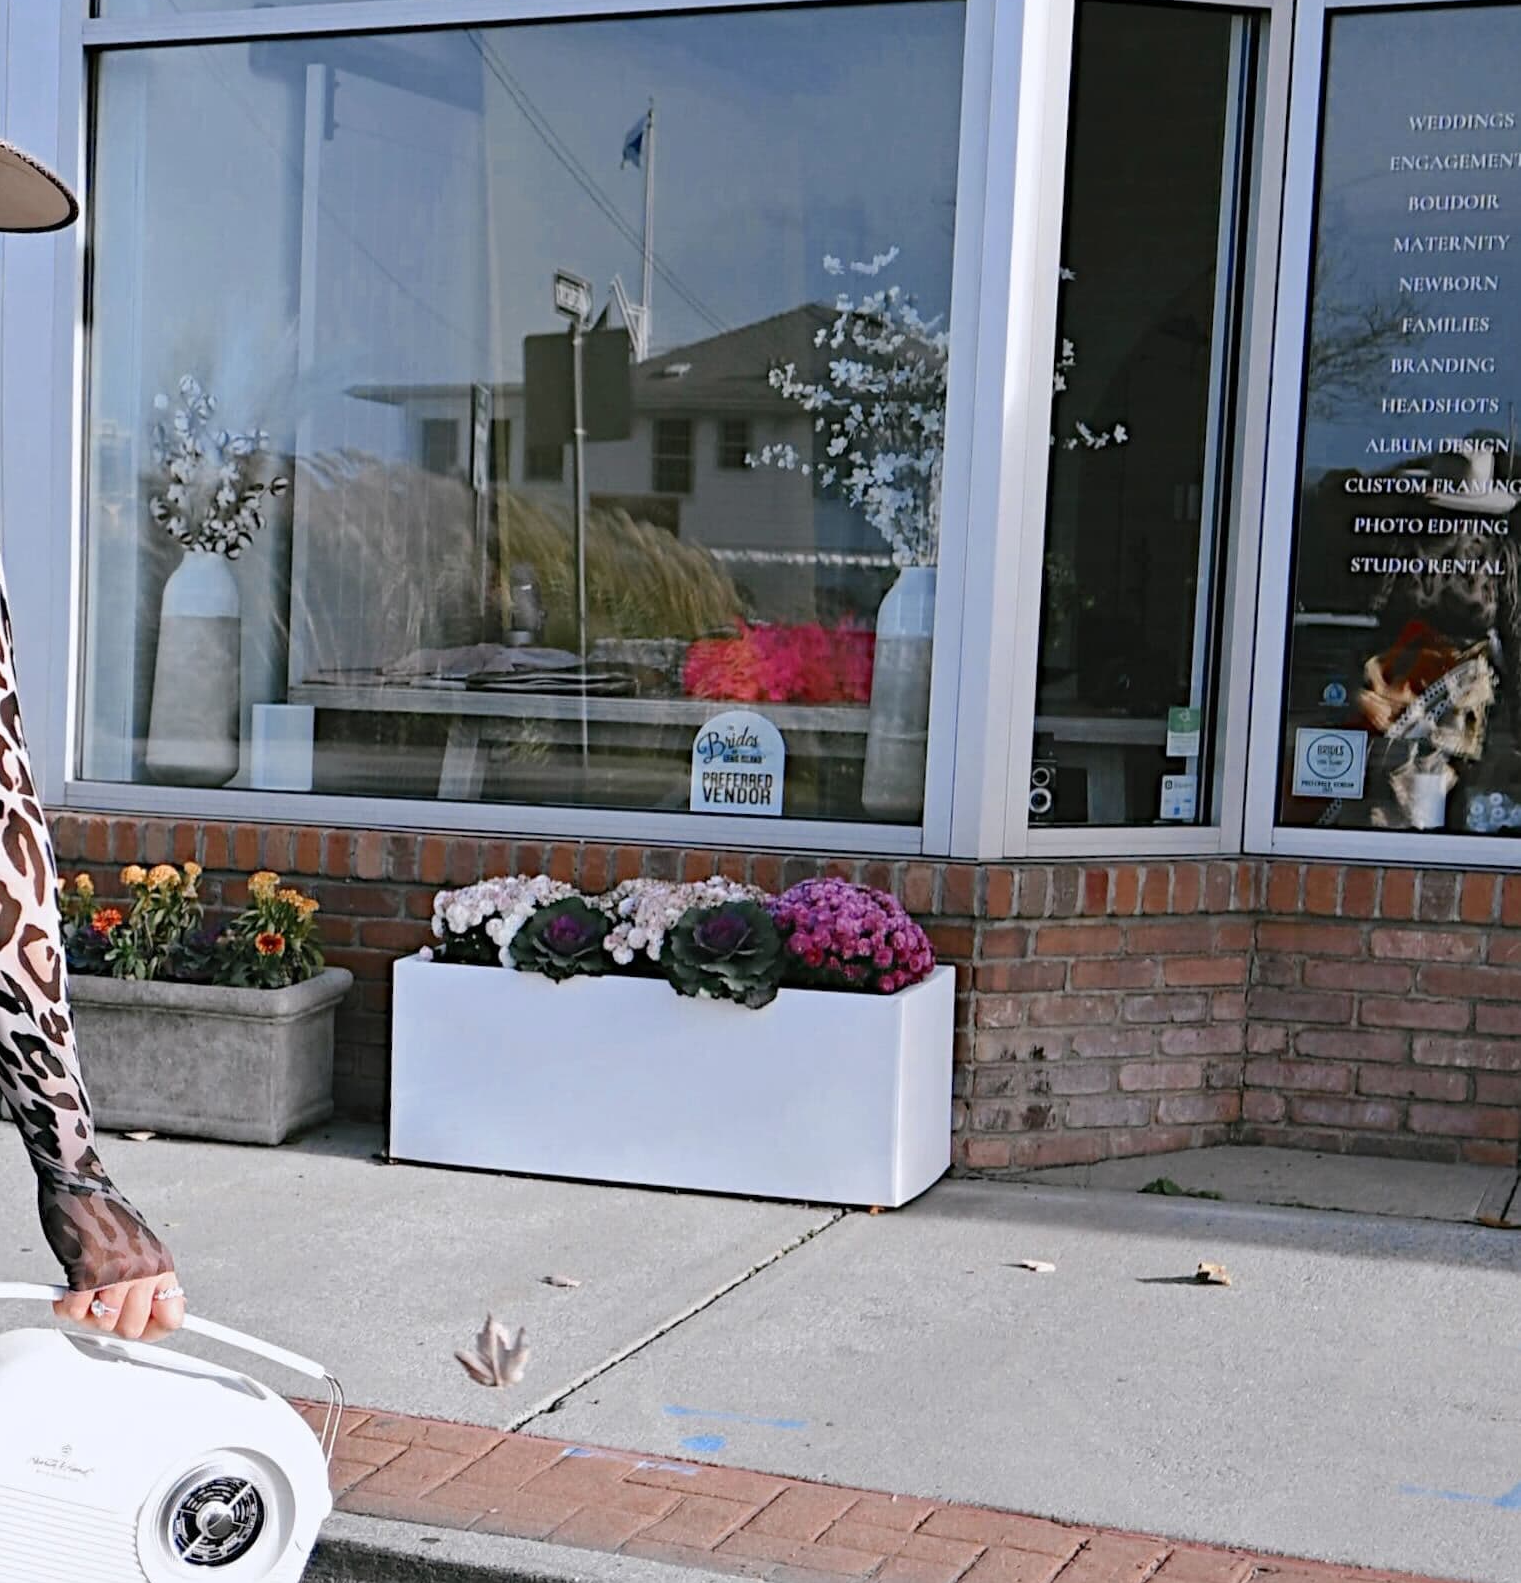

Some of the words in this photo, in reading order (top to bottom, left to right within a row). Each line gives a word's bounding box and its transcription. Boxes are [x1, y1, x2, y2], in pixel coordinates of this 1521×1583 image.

[1408, 112, 1515, 131] WEDDINGS
[1408, 194, 1499, 211] BOUDOIR
[1394, 234, 1510, 252] MATERNITY
[1399, 275, 1499, 293] NEWBORN
[1401, 317, 1490, 333] FAMILIES
[1391, 358, 1495, 373] BRANDING
[1382, 398, 1499, 414] HEADSHOTS
[1366, 439, 1432, 454] ALBUM
[1438, 438, 1510, 454] DESIGN
[1345, 478, 1427, 494] CUSTOM
[1432, 479, 1521, 495] FRAMING
[1354, 517, 1423, 534] PHOTO
[1428, 519, 1509, 535] EDITING
[1351, 557, 1423, 573] STUDIO
[1428, 559, 1506, 575] RENTAL
[702, 772, 773, 788] PREFERRED
[703, 787, 771, 806] VENDOR
